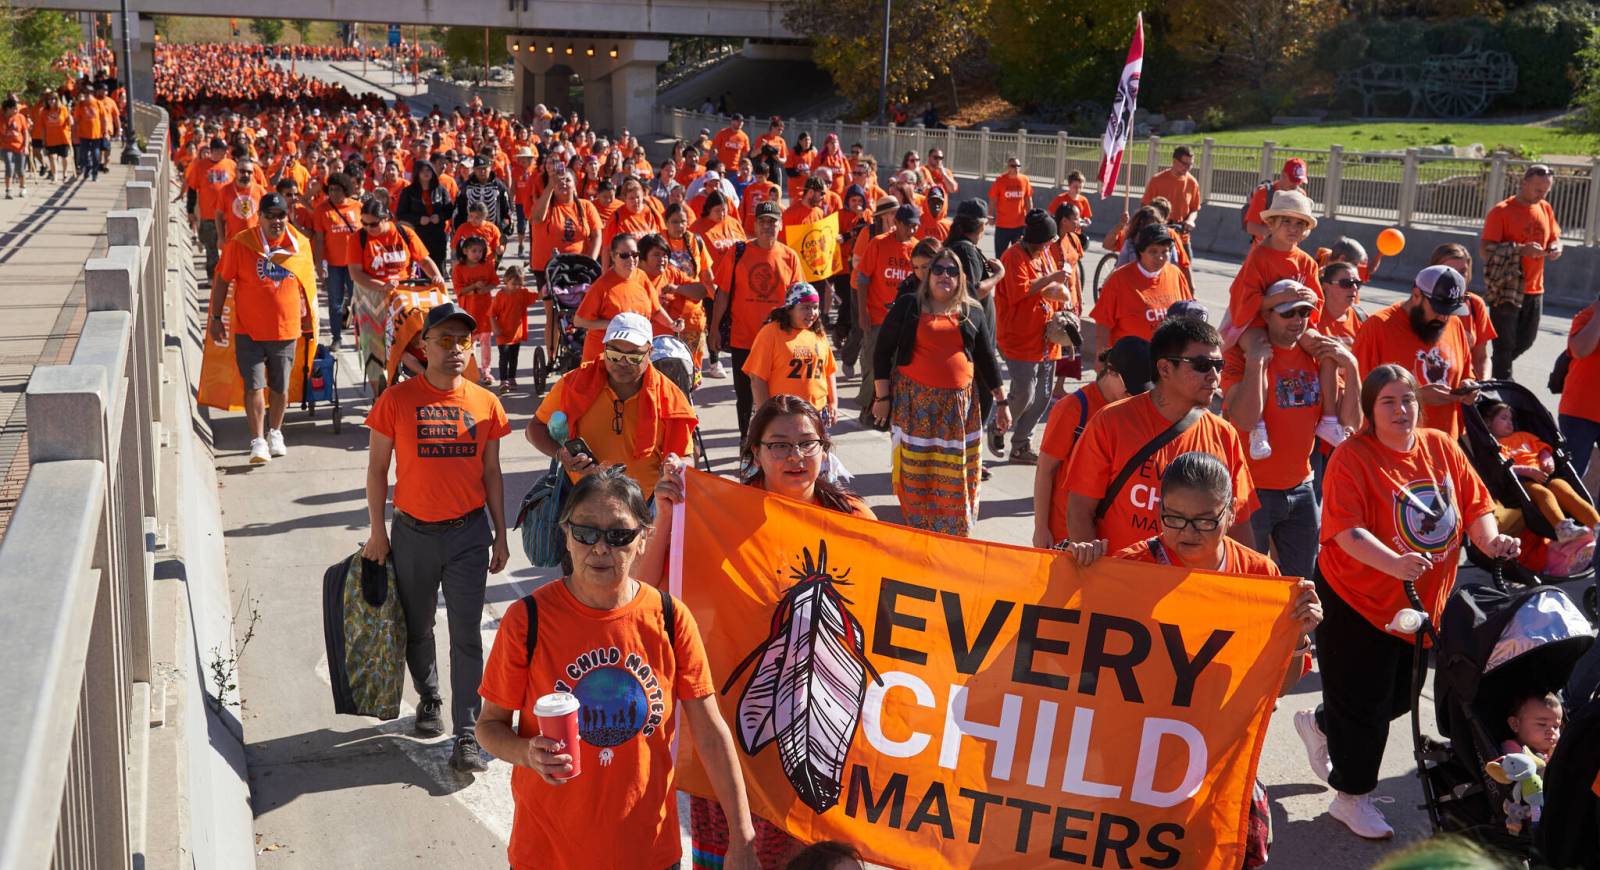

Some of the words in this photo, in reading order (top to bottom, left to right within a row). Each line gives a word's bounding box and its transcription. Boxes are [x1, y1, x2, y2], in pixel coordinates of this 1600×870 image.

[420, 409, 456, 417] EVERY
[421, 427, 454, 435] CHILD
[421, 446, 475, 454] MATTERS
[872, 577, 1233, 708] EVERY
[566, 647, 620, 680] CHILD
[625, 652, 664, 737] MATTERS
[863, 671, 1208, 808] CHILD
[845, 763, 1186, 869] MATTERS
